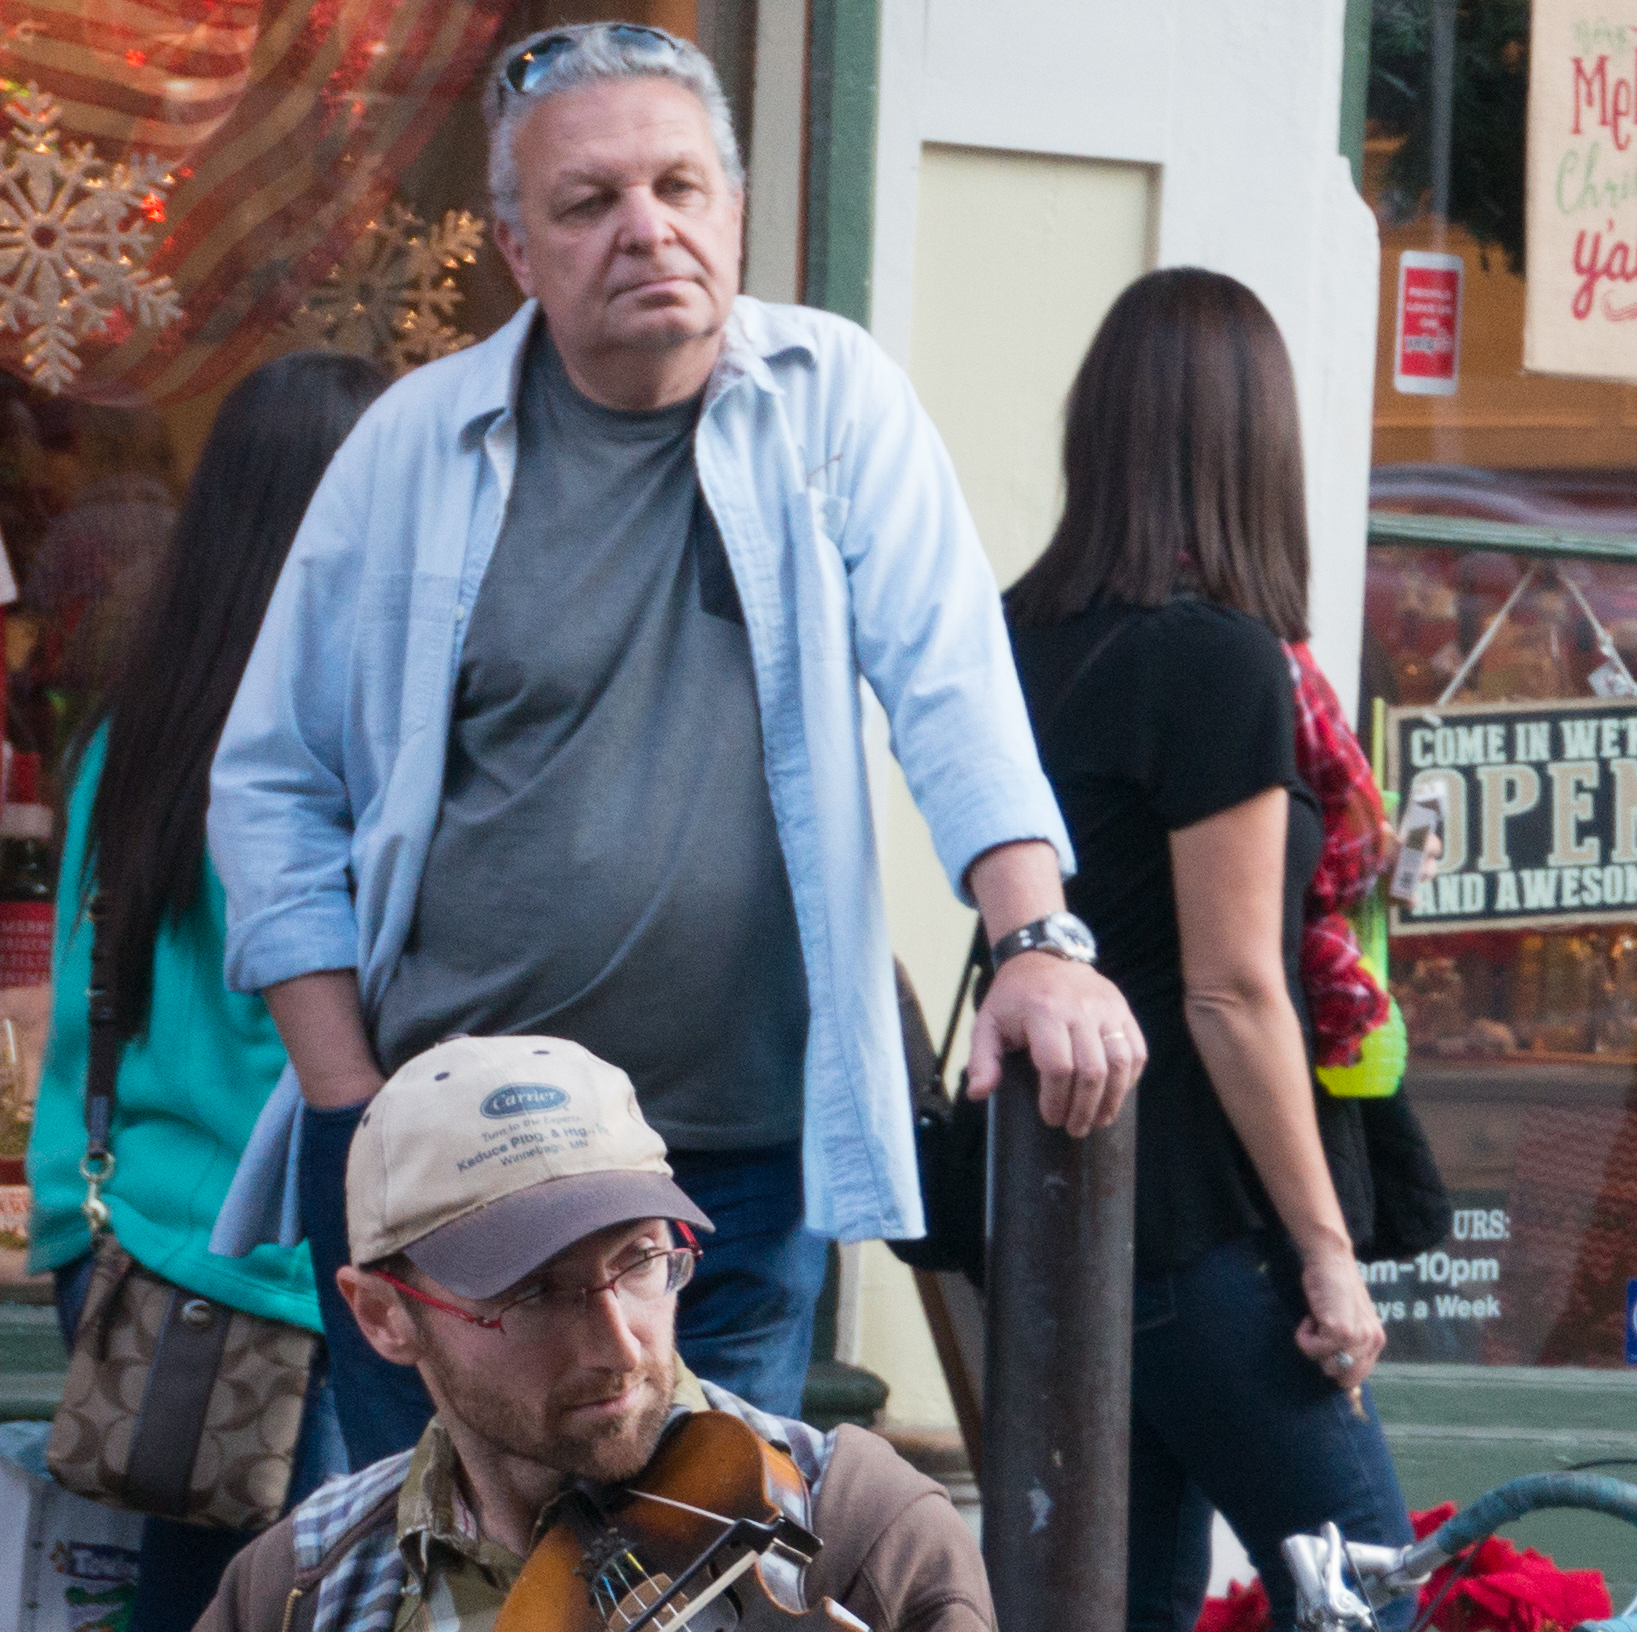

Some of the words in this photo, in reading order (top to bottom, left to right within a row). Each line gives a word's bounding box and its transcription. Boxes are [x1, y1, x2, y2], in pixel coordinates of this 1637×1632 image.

[1410, 724, 1506, 768] COME
[1515, 721, 1550, 761] IN
[1411, 872, 1485, 917] AND
[492, 1089, 557, 1111] Carrier
[481, 1128, 507, 1143] Turn
[508, 1122, 521, 1133] to
[569, 1140, 589, 1150] MN
[456, 1143, 509, 1173] Kaduce
[551, 1128, 560, 1138] &
[1453, 1209, 1512, 1241] URS:
[1412, 1300, 1429, 1319] a
[1435, 1293, 1502, 1319] Week
